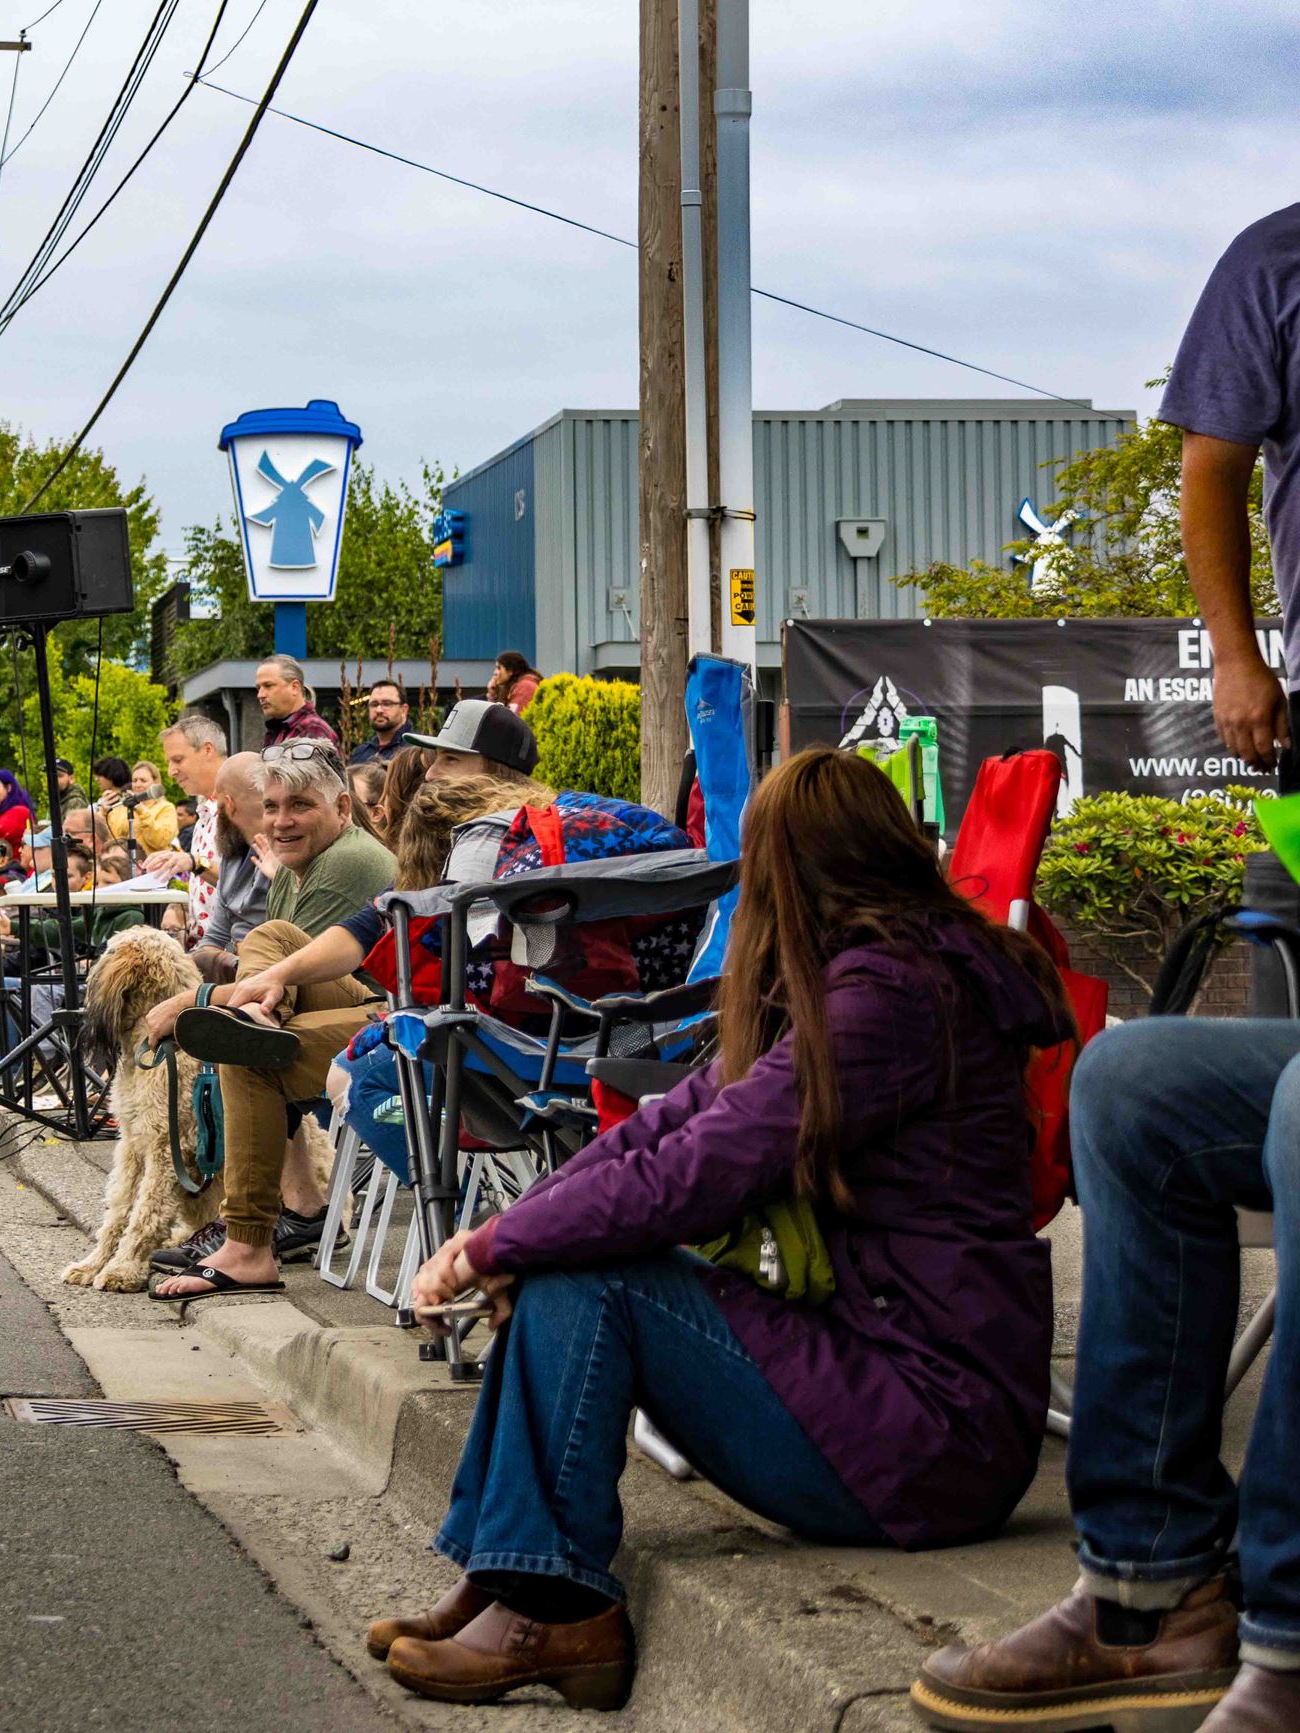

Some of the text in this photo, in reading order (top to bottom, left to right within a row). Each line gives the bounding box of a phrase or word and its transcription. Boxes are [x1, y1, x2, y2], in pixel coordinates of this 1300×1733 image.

[732, 571, 754, 580] CAUT
[1124, 678, 1216, 701] AN ESCA
